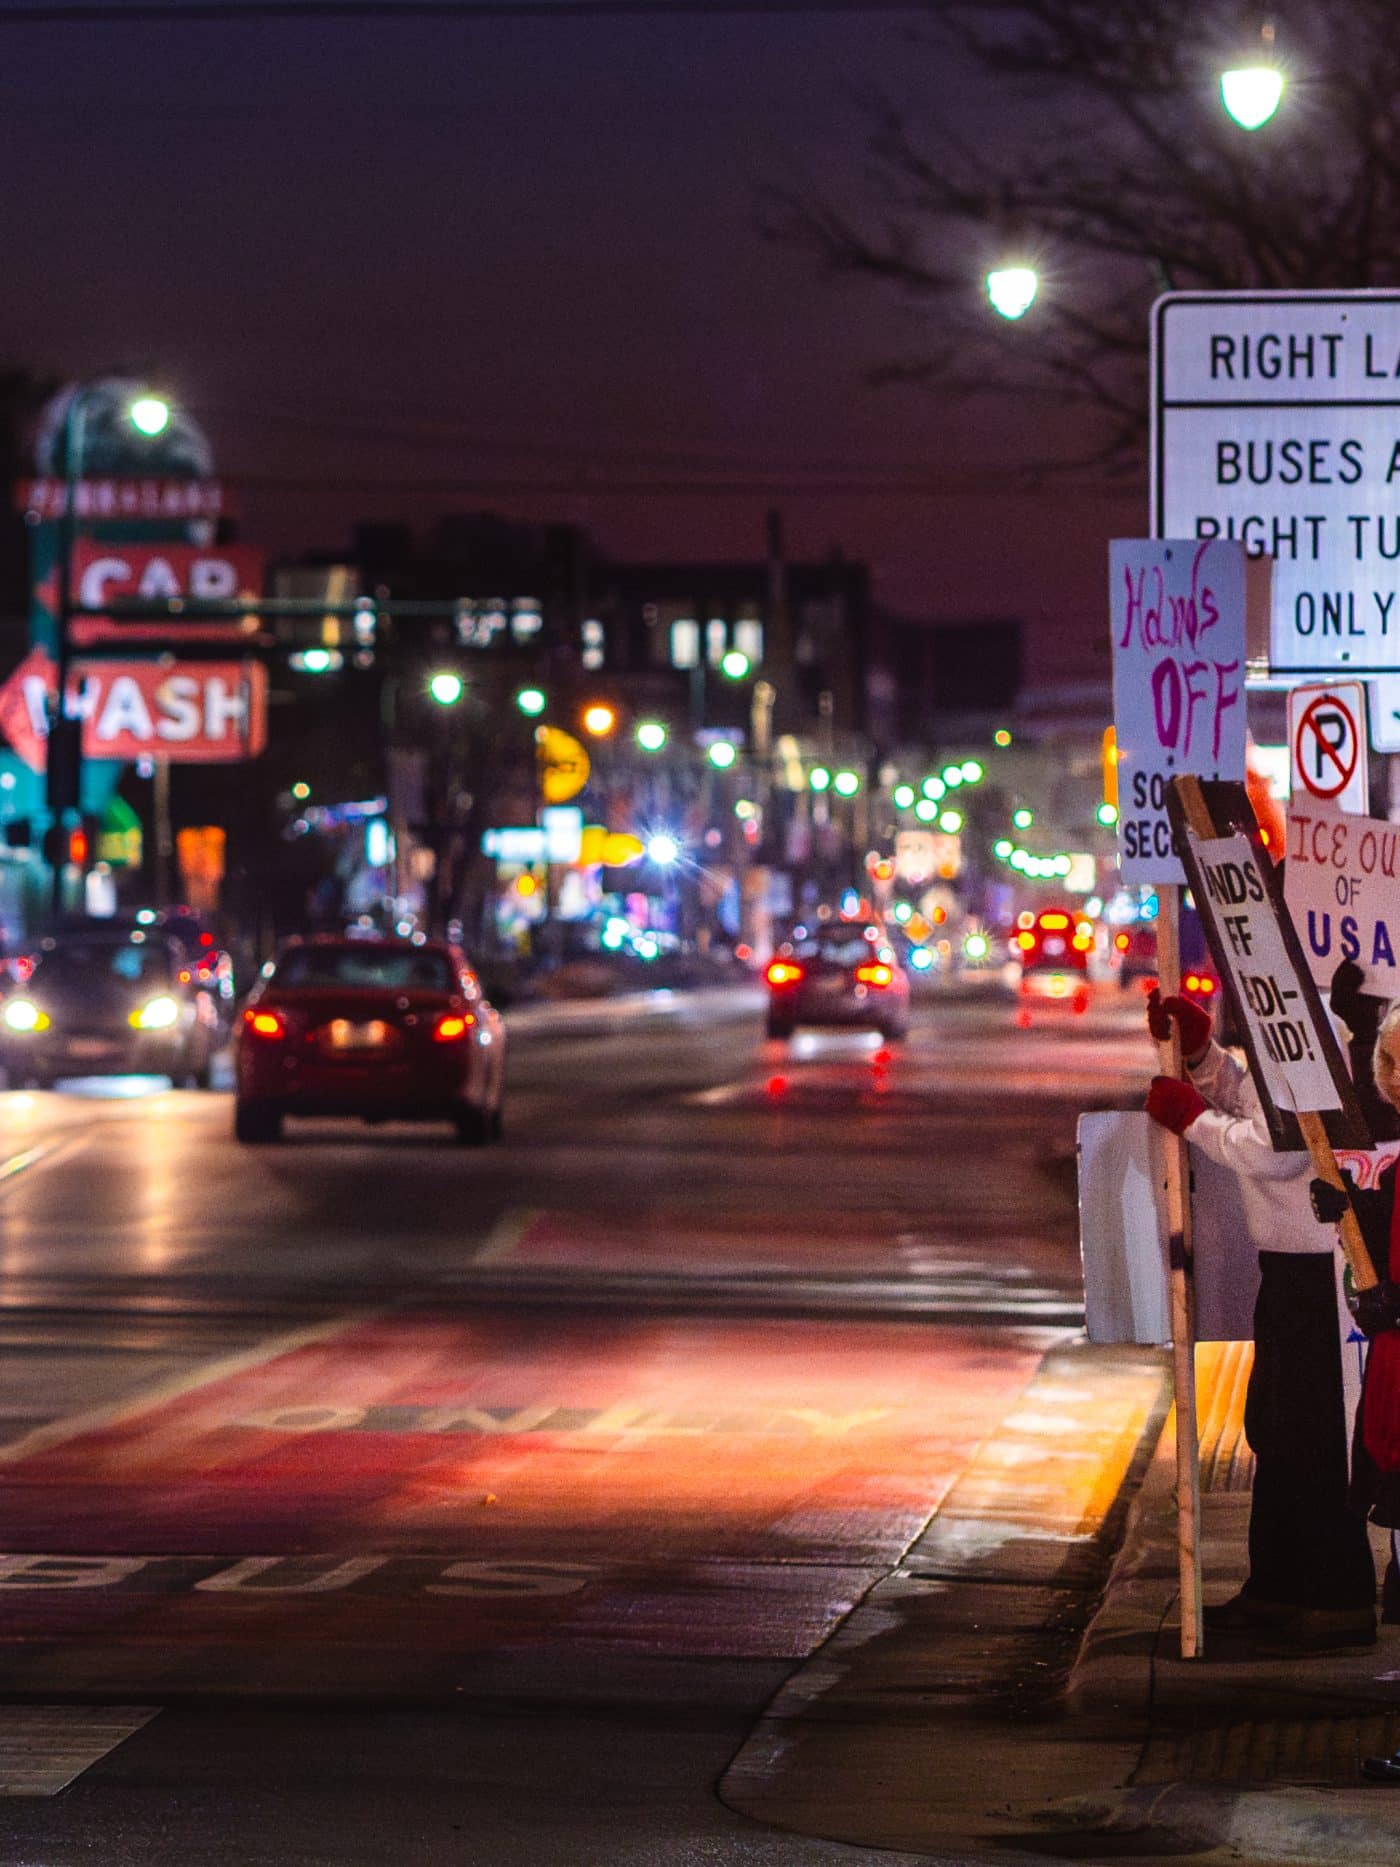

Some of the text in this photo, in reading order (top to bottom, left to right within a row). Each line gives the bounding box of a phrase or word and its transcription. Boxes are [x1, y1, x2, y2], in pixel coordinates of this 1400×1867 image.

[1210, 333, 1344, 379] RIGHT
[1216, 439, 1363, 485] BUSES
[1295, 591, 1396, 636] ONLY
[23, 674, 250, 741] WASH
[1152, 656, 1240, 761] OFF
[1290, 815, 1348, 869] ICE
[1335, 875, 1362, 906] OF
[1307, 909, 1397, 968] USA
[0, 1555, 601, 1595] BUS
